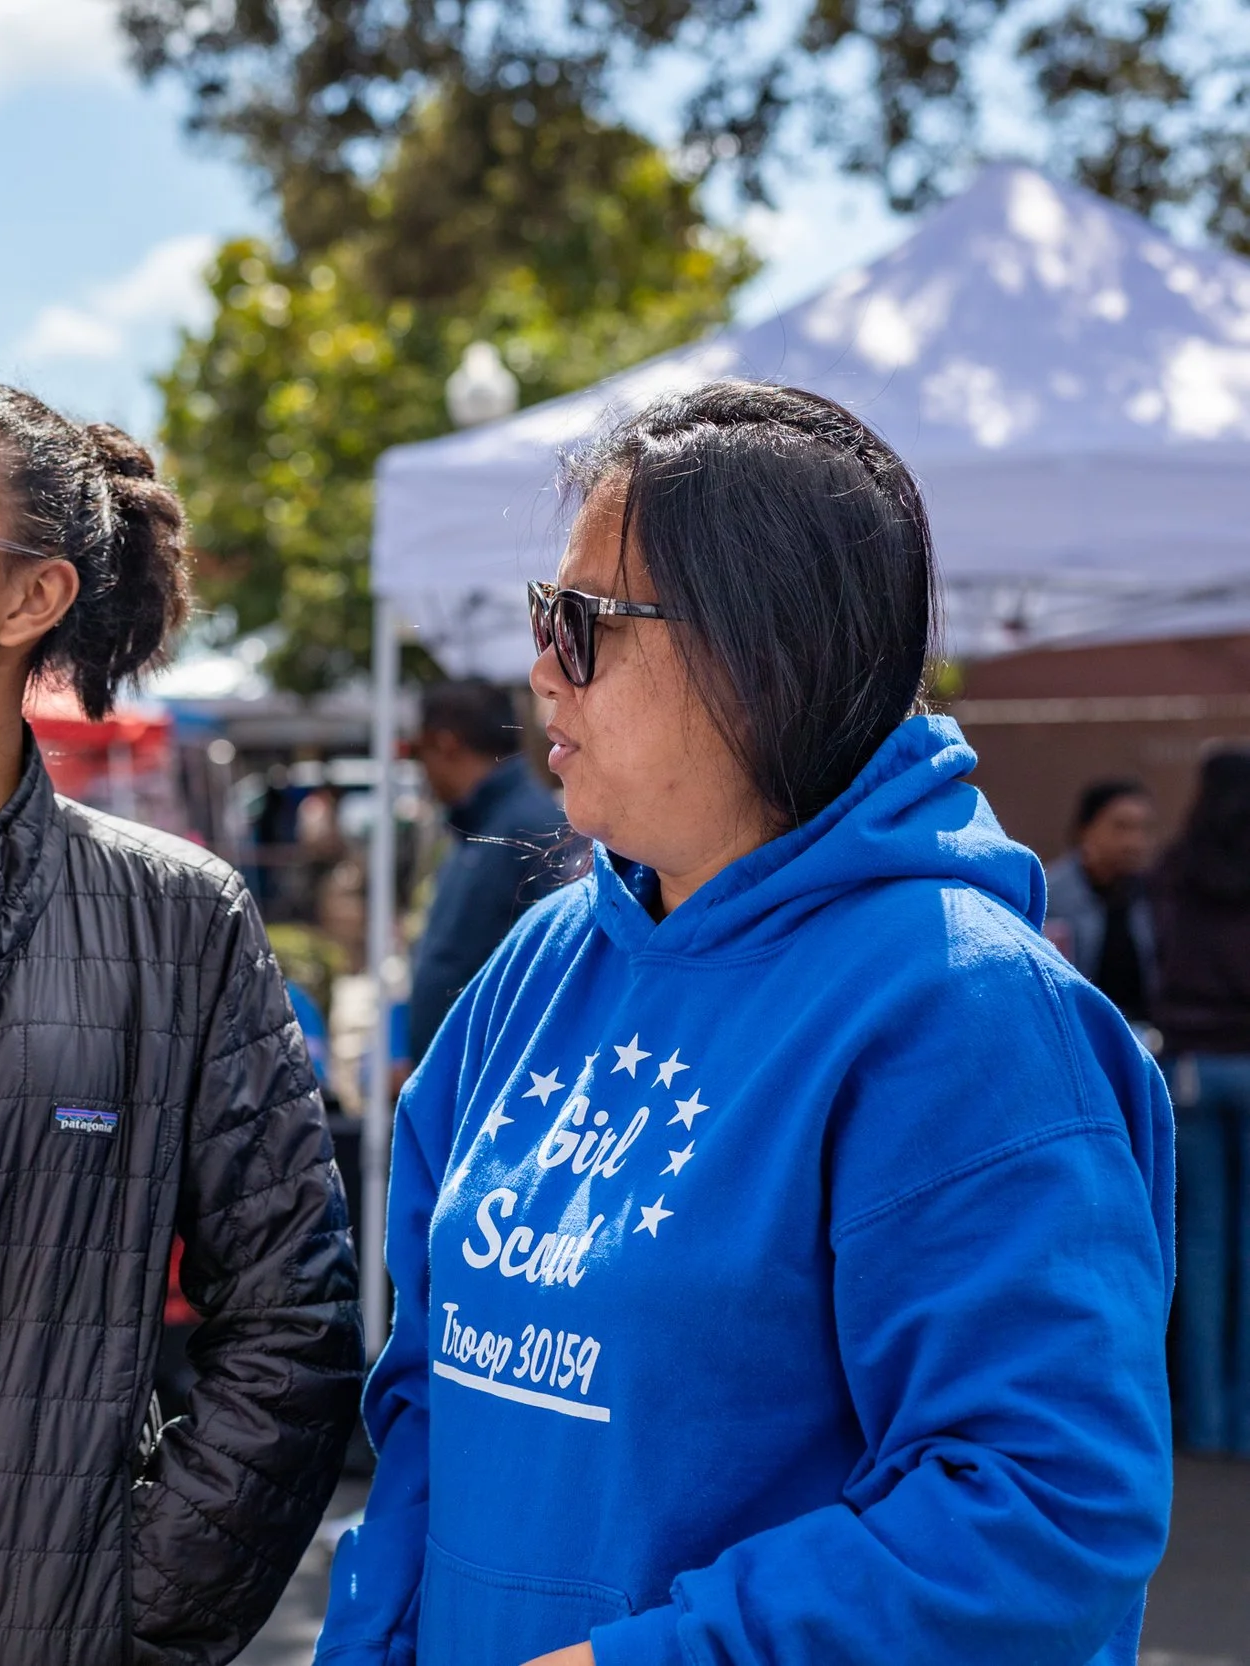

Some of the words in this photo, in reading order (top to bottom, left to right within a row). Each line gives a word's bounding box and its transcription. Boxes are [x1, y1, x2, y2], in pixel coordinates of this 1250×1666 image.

[60, 1119, 113, 1133] patagonia
[537, 1095, 650, 1179] Girl
[462, 1188, 605, 1288] Scout
[442, 1302, 513, 1380] Troop
[512, 1323, 601, 1395] 30159
